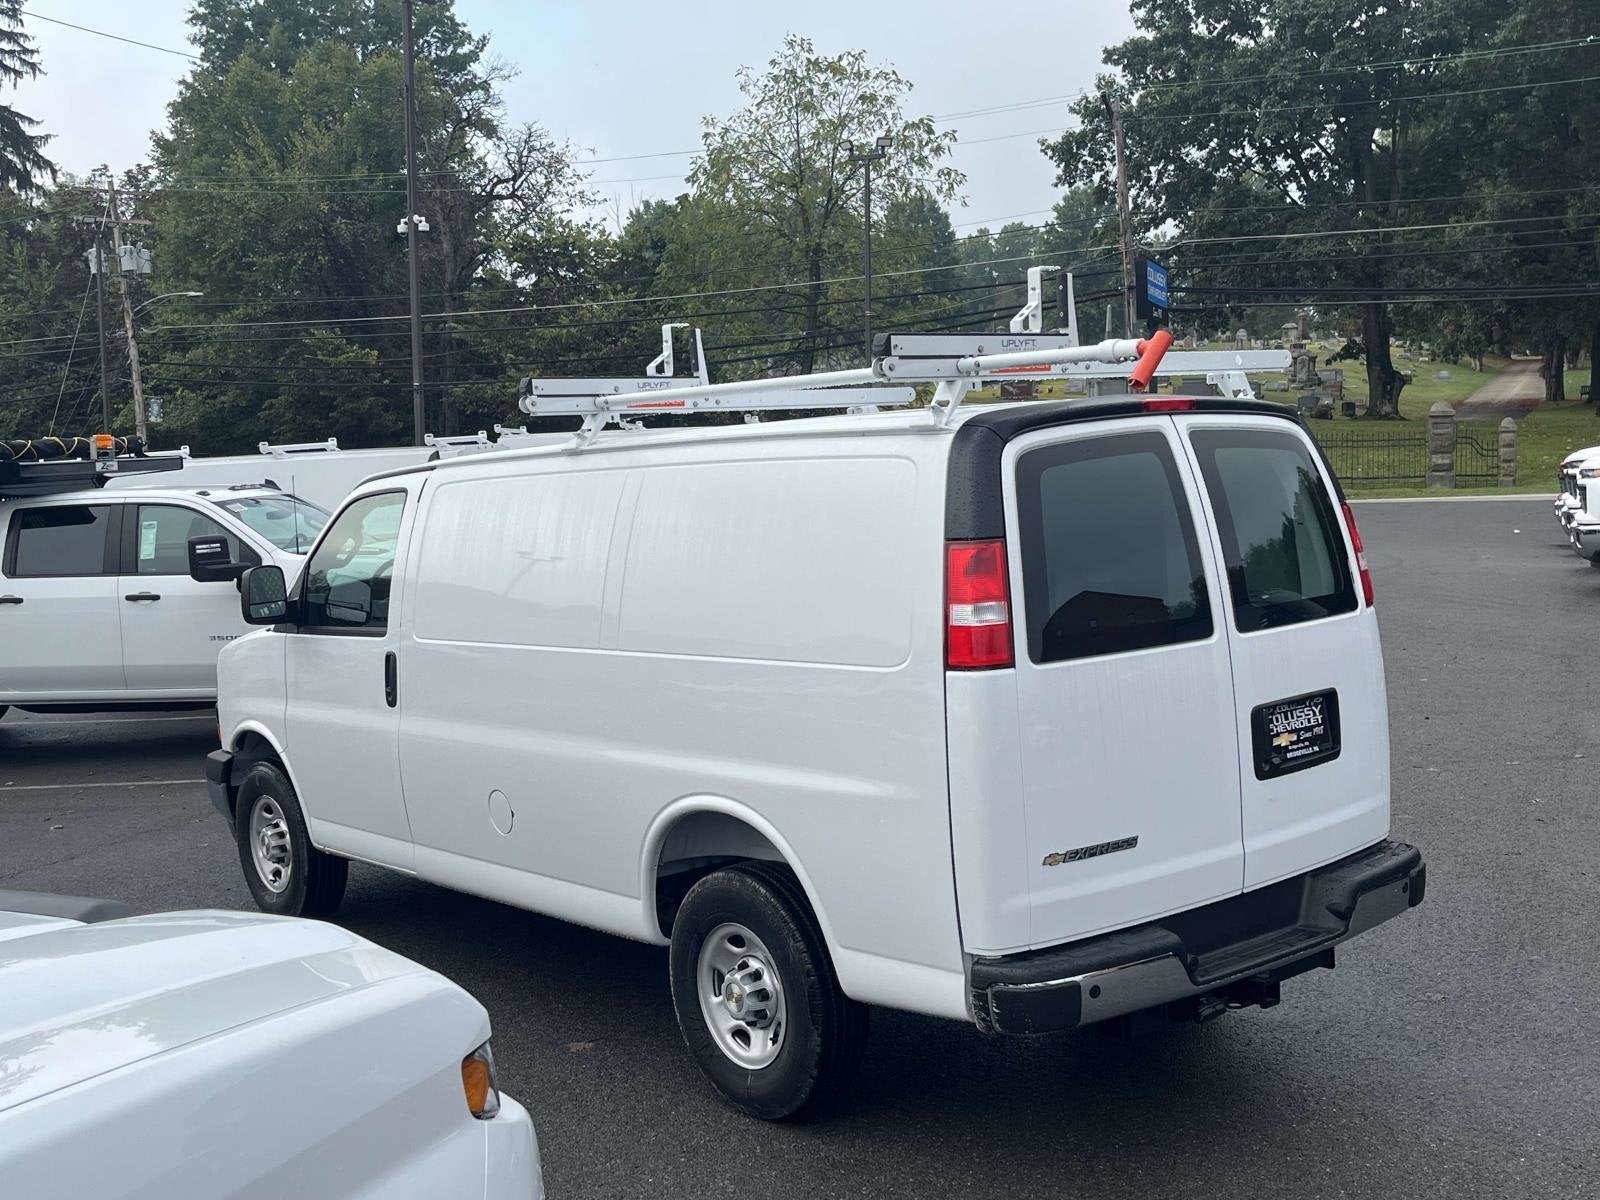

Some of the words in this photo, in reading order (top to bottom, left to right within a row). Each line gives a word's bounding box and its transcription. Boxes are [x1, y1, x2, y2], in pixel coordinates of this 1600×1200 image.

[1001, 339, 1037, 348] UPLYFT
[637, 381, 671, 389] UPLYFT
[1268, 704, 1322, 726] OLUSSY
[1063, 835, 1139, 863] EXPRESS
